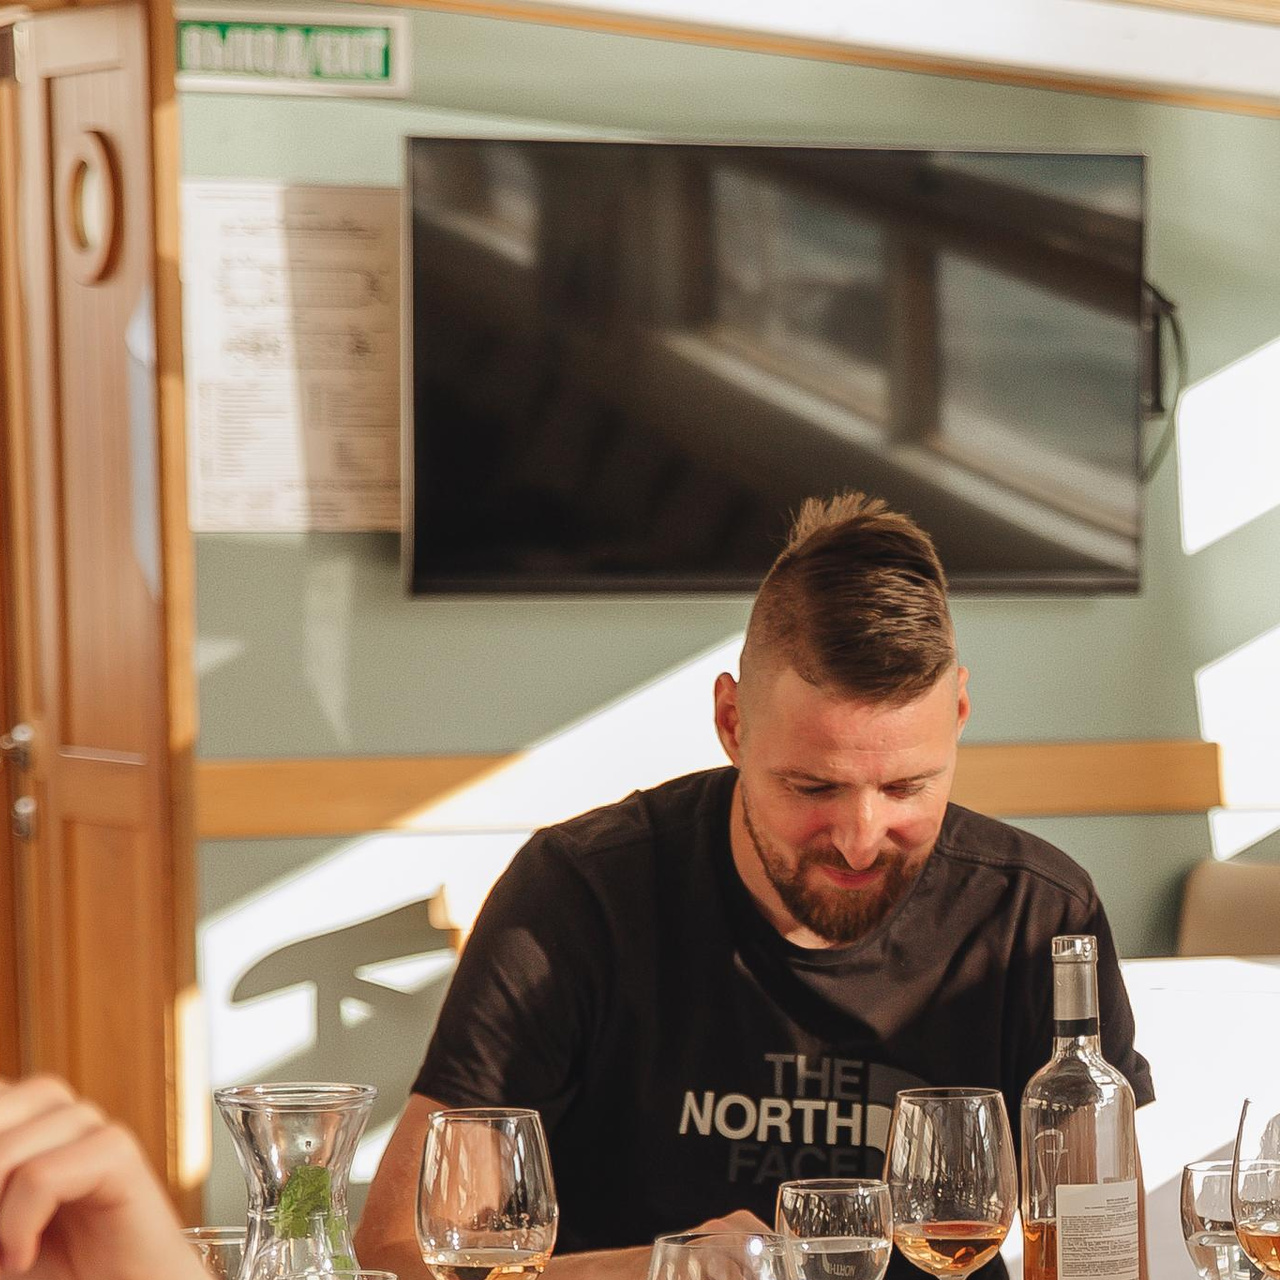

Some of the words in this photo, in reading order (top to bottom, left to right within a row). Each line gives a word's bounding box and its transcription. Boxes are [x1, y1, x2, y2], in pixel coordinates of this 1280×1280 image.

[764, 1054, 863, 1099] THE
[678, 1090, 862, 1147] NORTH
[726, 1144, 859, 1184] FACE
